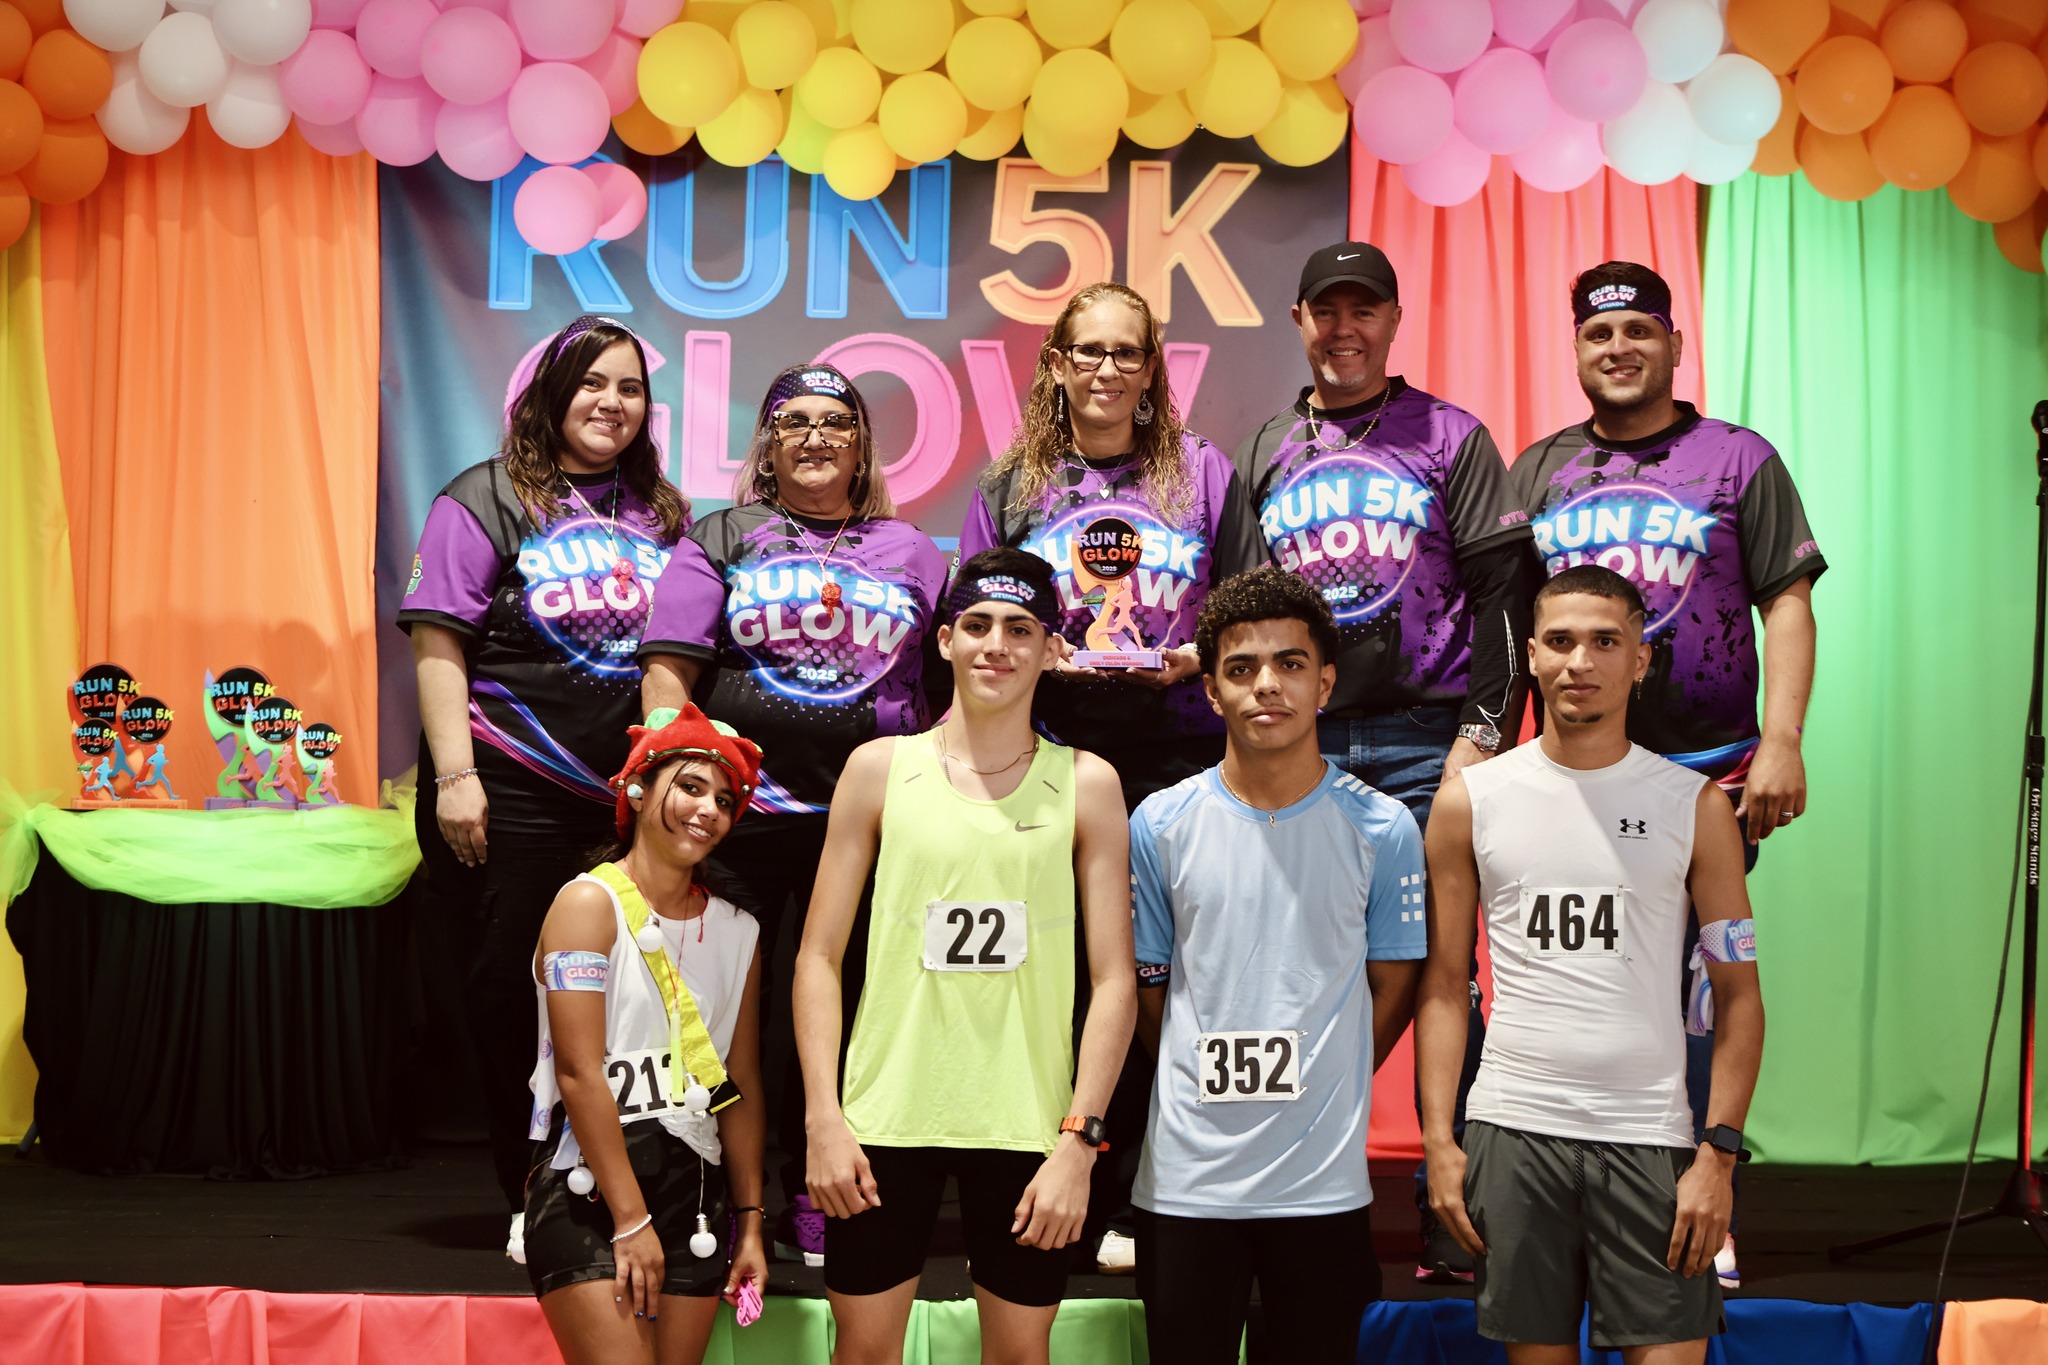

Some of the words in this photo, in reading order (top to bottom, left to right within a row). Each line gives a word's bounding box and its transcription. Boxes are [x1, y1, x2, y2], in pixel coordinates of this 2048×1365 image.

[487, 153, 951, 319] RUN
[980, 156, 1264, 328] 5K
[1588, 284, 1615, 301] RUN
[1618, 284, 1637, 296] 5K
[1590, 292, 1635, 306] GLOW
[801, 371, 831, 381] RUN
[805, 379, 847, 393] GLOW
[1260, 478, 1350, 544] RUN
[1363, 478, 1435, 528] 5K
[1499, 510, 1528, 526] UTU
[1077, 532, 1117, 548] RUN
[1121, 533, 1145, 550] 5K
[1532, 505, 1632, 561] RUN
[1641, 505, 1717, 554] 5K
[1083, 547, 1138, 562] GLOW
[1140, 529, 1204, 579] 5K
[1274, 519, 1420, 574] GLOW
[517, 539, 621, 586] RUN
[977, 575, 1015, 587] RUN
[1018, 580, 1037, 597] 5K
[981, 583, 1033, 601] GLOW
[1322, 585, 1358, 600] 2025
[727, 569, 835, 614] RUN
[853, 581, 920, 625] 5K
[730, 603, 911, 655] GLOW
[600, 639, 639, 652] 2025
[797, 666, 838, 681] 2025
[73, 677, 113, 695] RUN
[118, 679, 143, 695] 5K
[209, 681, 249, 698] RUN
[253, 682, 278, 698] 5K
[215, 695, 264, 711] GLO
[121, 707, 152, 721] RUN
[155, 708, 175, 721] 5K
[250, 708, 280, 721] RUN
[283, 708, 303, 721] 5K
[75, 727, 101, 737] RUN
[102, 728, 119, 740] 5K
[126, 719, 170, 732] GLOW
[253, 719, 297, 733] GLOW
[78, 736, 113, 748] GLOW
[300, 731, 325, 741] RUN
[327, 732, 343, 743] 5K
[303, 740, 338, 752] GLOW
[2029, 787, 2041, 842] On-Stage
[2028, 844, 2040, 886] Stands
[1526, 893, 1619, 951] 464
[946, 908, 1006, 965] 22
[566, 967, 608, 980] GLOW
[1205, 1036, 1294, 1095] 352
